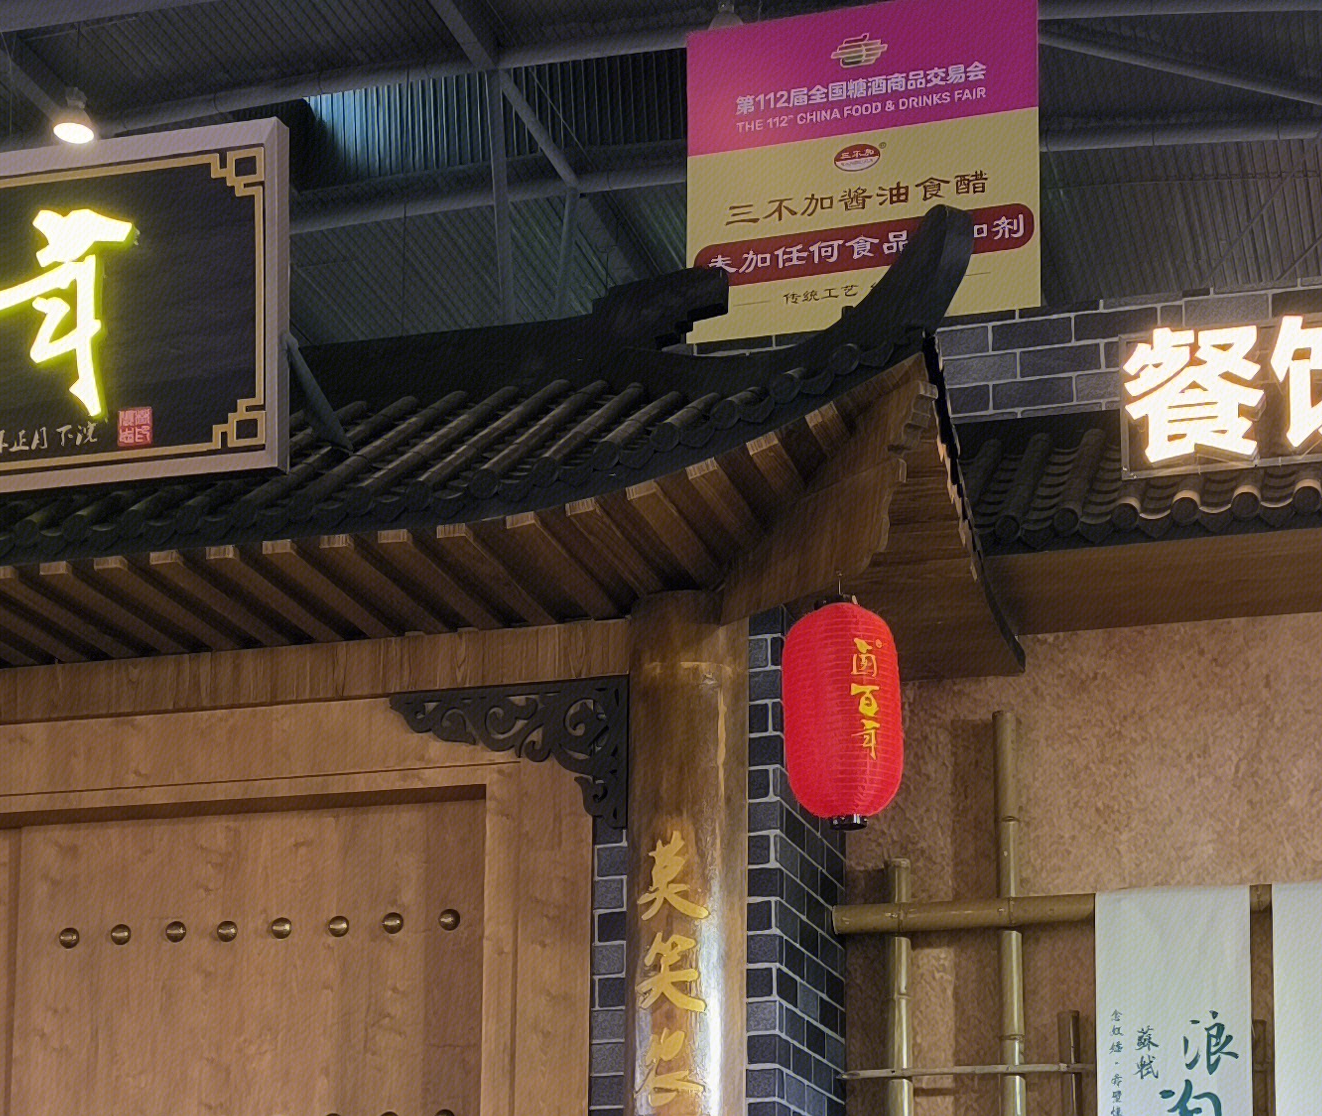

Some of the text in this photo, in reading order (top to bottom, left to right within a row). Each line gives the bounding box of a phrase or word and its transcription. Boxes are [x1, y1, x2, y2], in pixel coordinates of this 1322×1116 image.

[736, 61, 987, 115] 第112届全国糖酒商品交易会
[737, 117, 764, 133] THE
[796, 107, 841, 125] CHINA
[843, 102, 882, 117] FOOD
[885, 100, 895, 112] &
[899, 91, 951, 110] DRINKS
[954, 86, 987, 101] FAIR
[725, 169, 989, 226] 三不加酱油食醋
